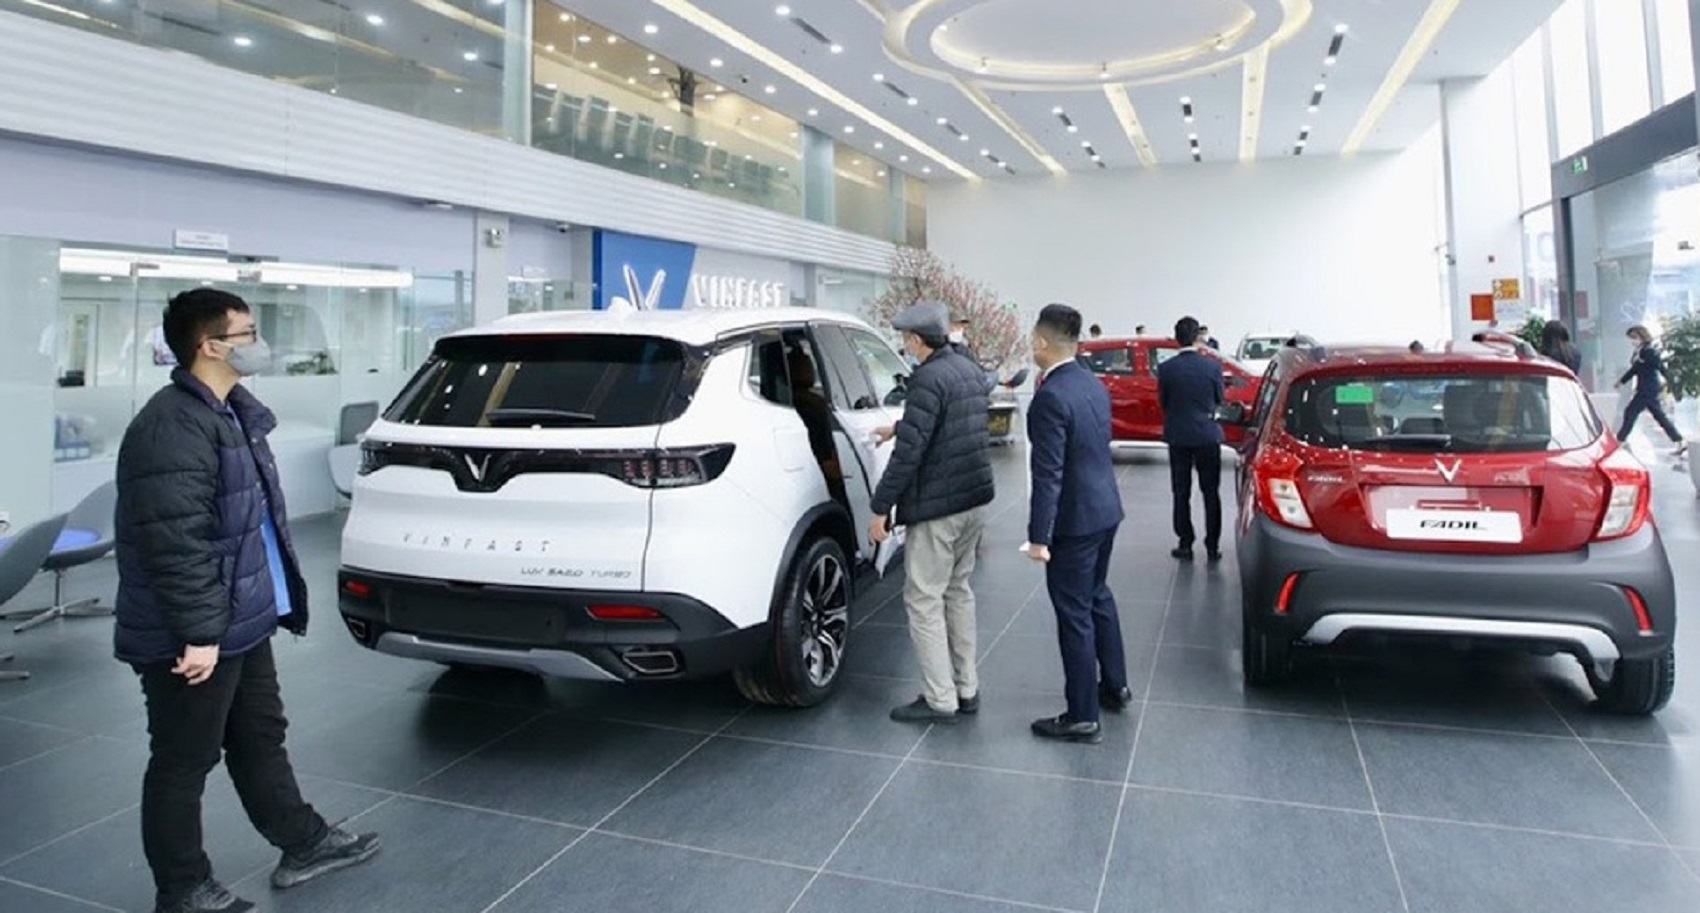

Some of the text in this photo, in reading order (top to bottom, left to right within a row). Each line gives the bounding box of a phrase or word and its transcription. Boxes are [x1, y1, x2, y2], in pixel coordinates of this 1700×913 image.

[692, 273, 785, 308] VINFAST
[1420, 519, 1488, 531] FADIL
[403, 533, 551, 552] VINFAST
